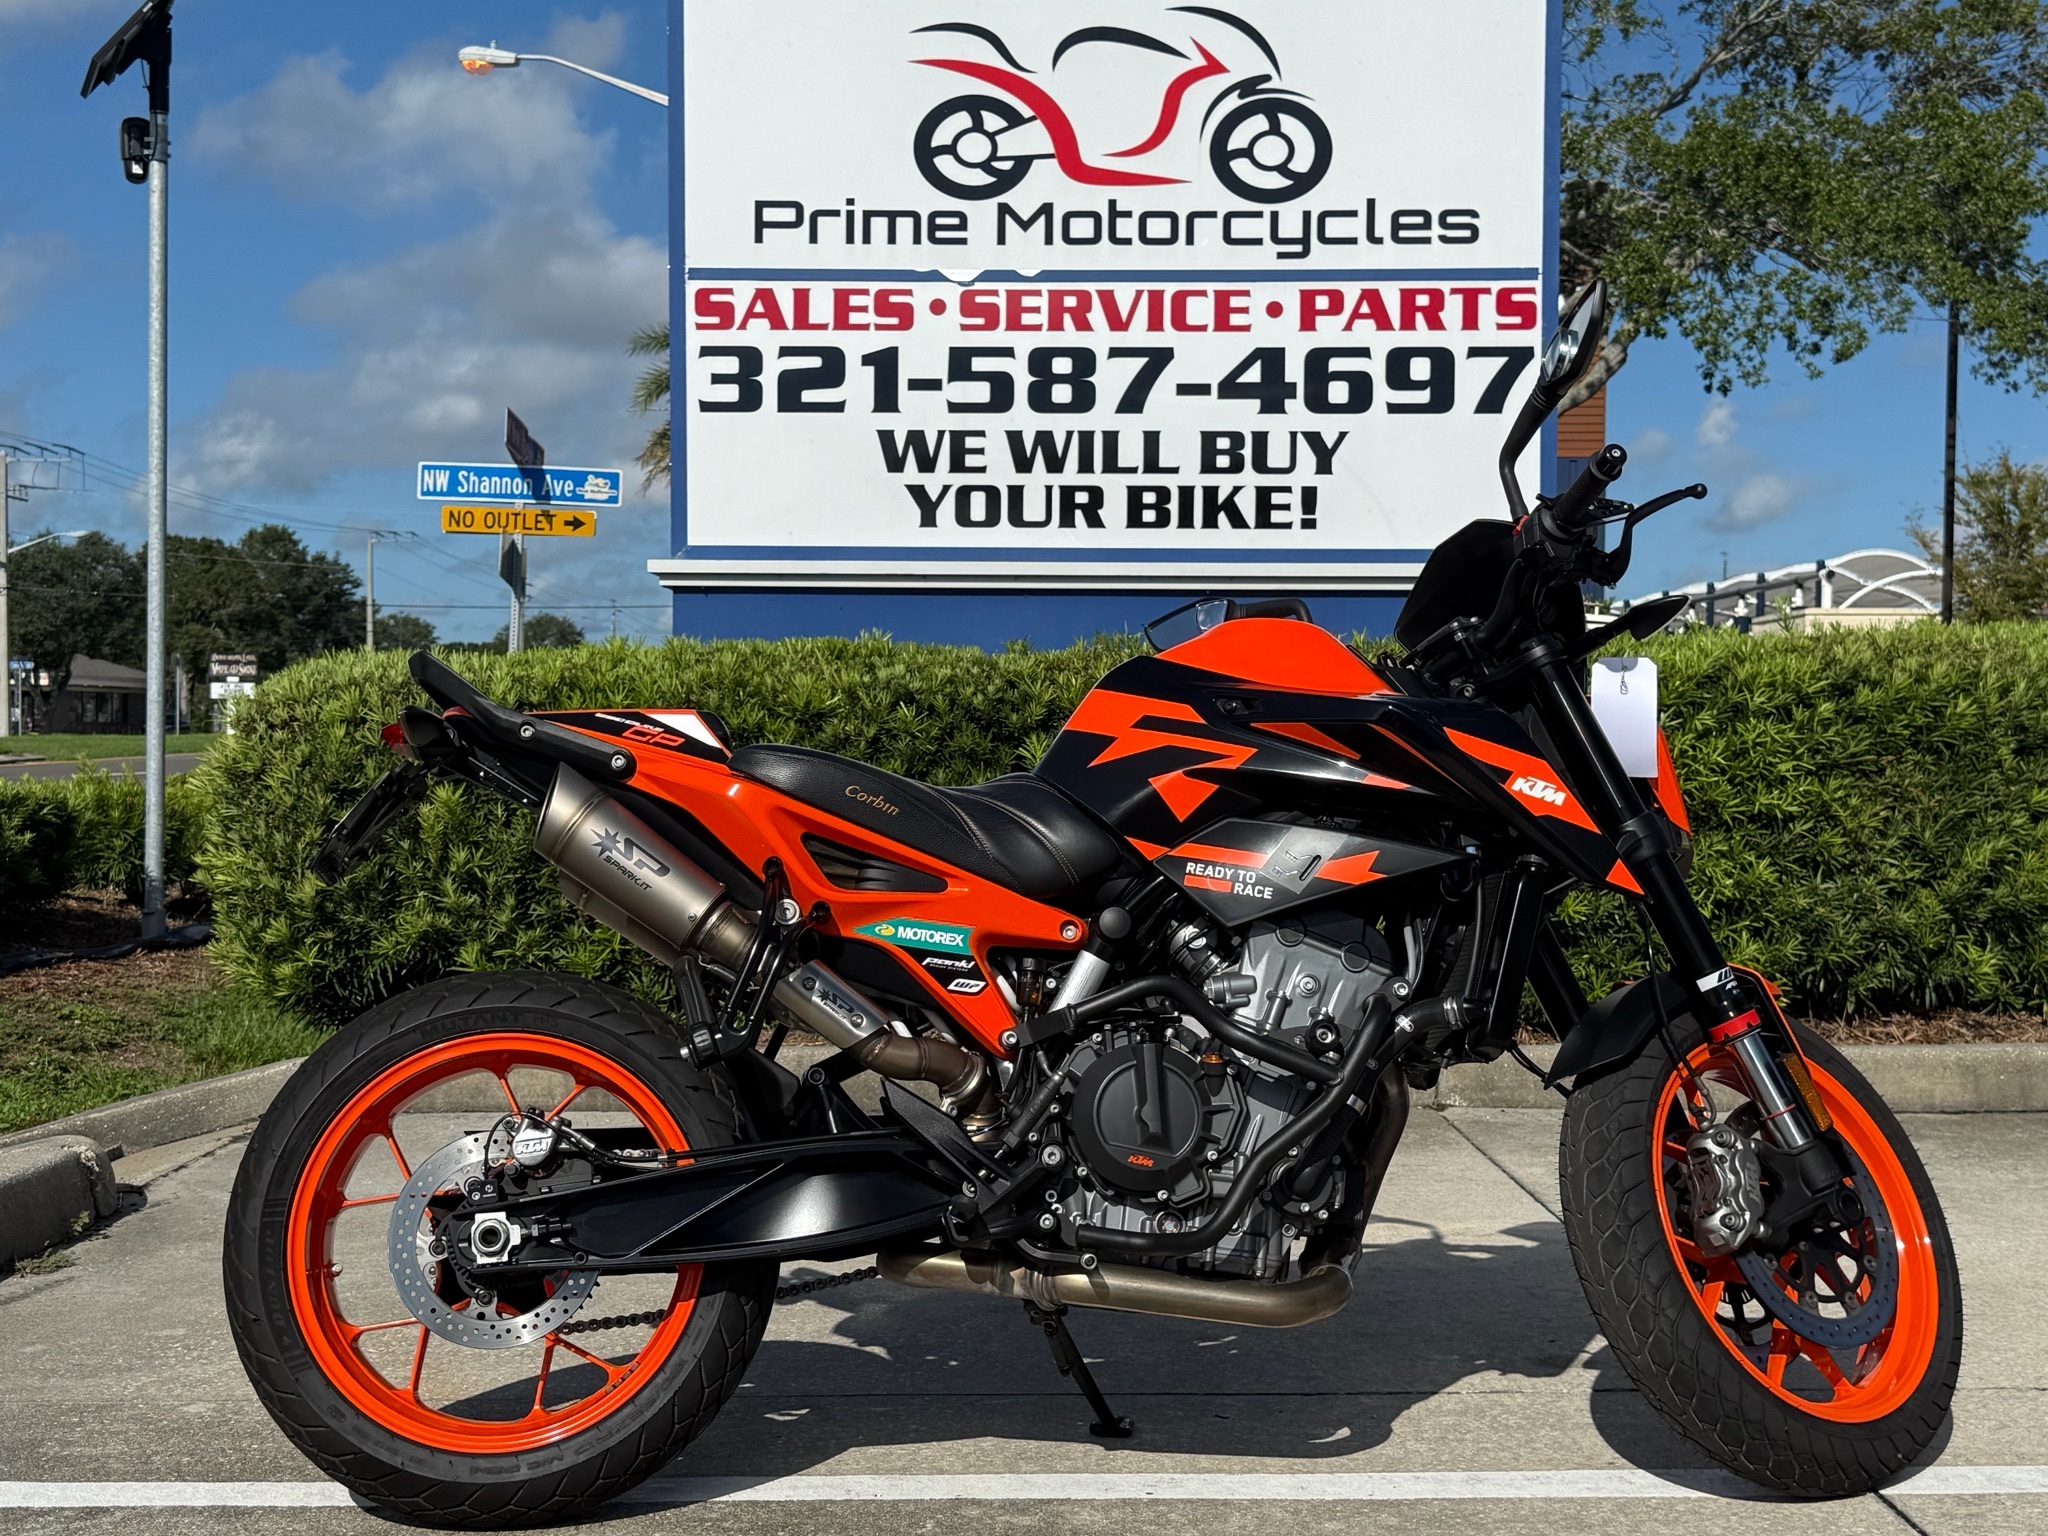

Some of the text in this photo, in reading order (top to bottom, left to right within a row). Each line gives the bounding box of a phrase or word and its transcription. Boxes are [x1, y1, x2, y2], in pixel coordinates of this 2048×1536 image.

[754, 198, 1480, 260] Prime Motorcycles
[694, 287, 1537, 333] SALES SERVICE PARTS
[697, 345, 1536, 415] 321-587-4697
[875, 429, 1350, 475] WE WILL BUY
[423, 469, 574, 498] NW Shannon Ave
[448, 510, 557, 532] NO OUTLET
[904, 484, 1318, 530] YOUR BIKE!
[622, 726, 686, 747] GP
[845, 785, 900, 816] Corbin
[1510, 776, 1567, 806] KTM
[1185, 862, 1257, 884] READY TO
[1233, 882, 1274, 900] RACE
[897, 925, 964, 947] MOTOREX
[921, 957, 976, 969] pankl
[418, 1011, 525, 1039] MUTANT
[1128, 1154, 1155, 1168] KTM
